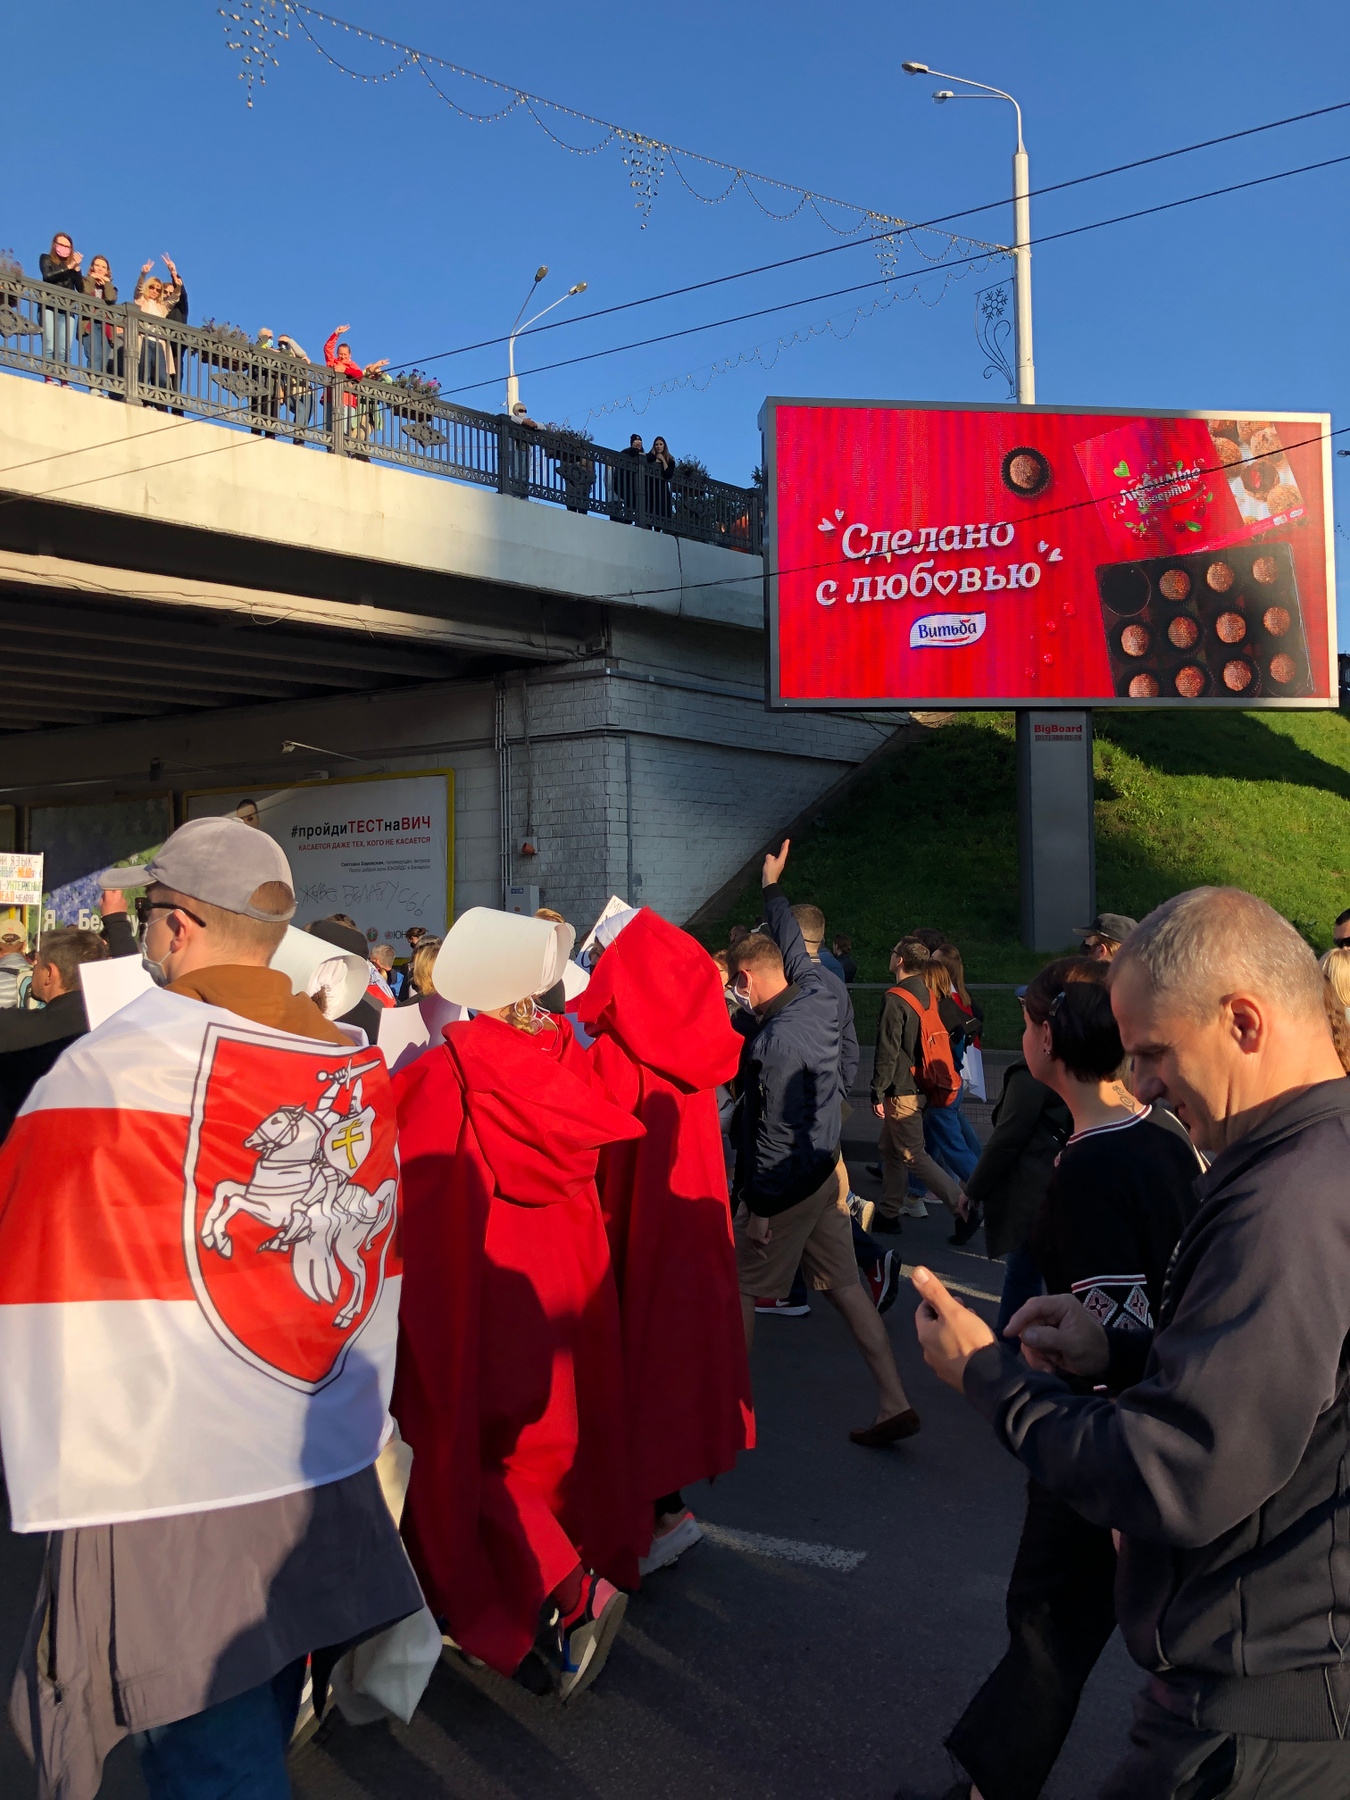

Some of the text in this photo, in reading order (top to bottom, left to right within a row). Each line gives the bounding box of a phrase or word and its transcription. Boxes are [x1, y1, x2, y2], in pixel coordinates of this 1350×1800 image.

[841, 521, 1015, 564] Сделано
[816, 580, 839, 606] с
[918, 619, 977, 639] Витьба
[1034, 724, 1083, 734] BigBoard
[291, 815, 431, 840] #пройдиТЕСТнаВИЧ
[298, 842, 331, 852] КАСАЕТСЯ
[332, 841, 351, 850] ДАЖЕ
[366, 839, 385, 847] КОГО
[385, 838, 395, 847] НЕ
[395, 836, 431, 846] КАСАЕТСЯ
